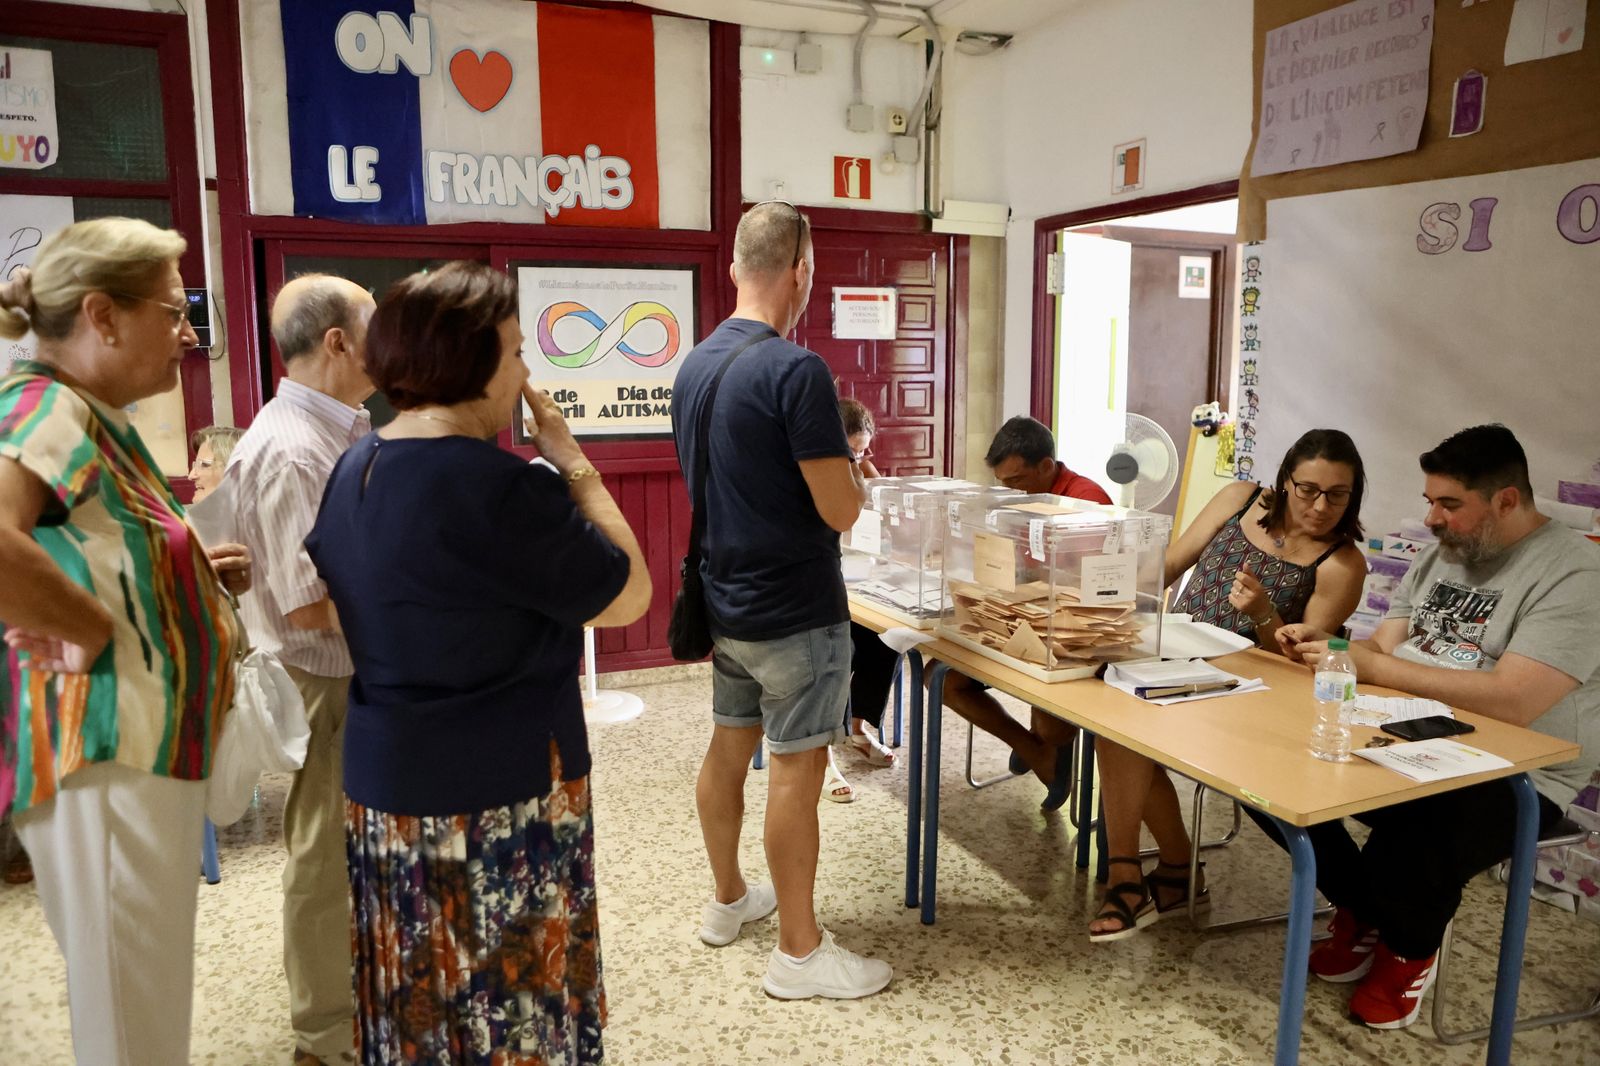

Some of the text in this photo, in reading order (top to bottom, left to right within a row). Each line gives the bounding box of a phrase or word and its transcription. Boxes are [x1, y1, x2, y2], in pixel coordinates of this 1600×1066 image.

[335, 11, 432, 76] ON
[1289, 46, 1360, 84] DERNIER
[328, 144, 634, 218] LE FRANÇAIS
[1417, 197, 1499, 255] SI
[553, 389, 578, 403] de
[617, 385, 648, 401] Día
[1453, 650, 1475, 659] 66
